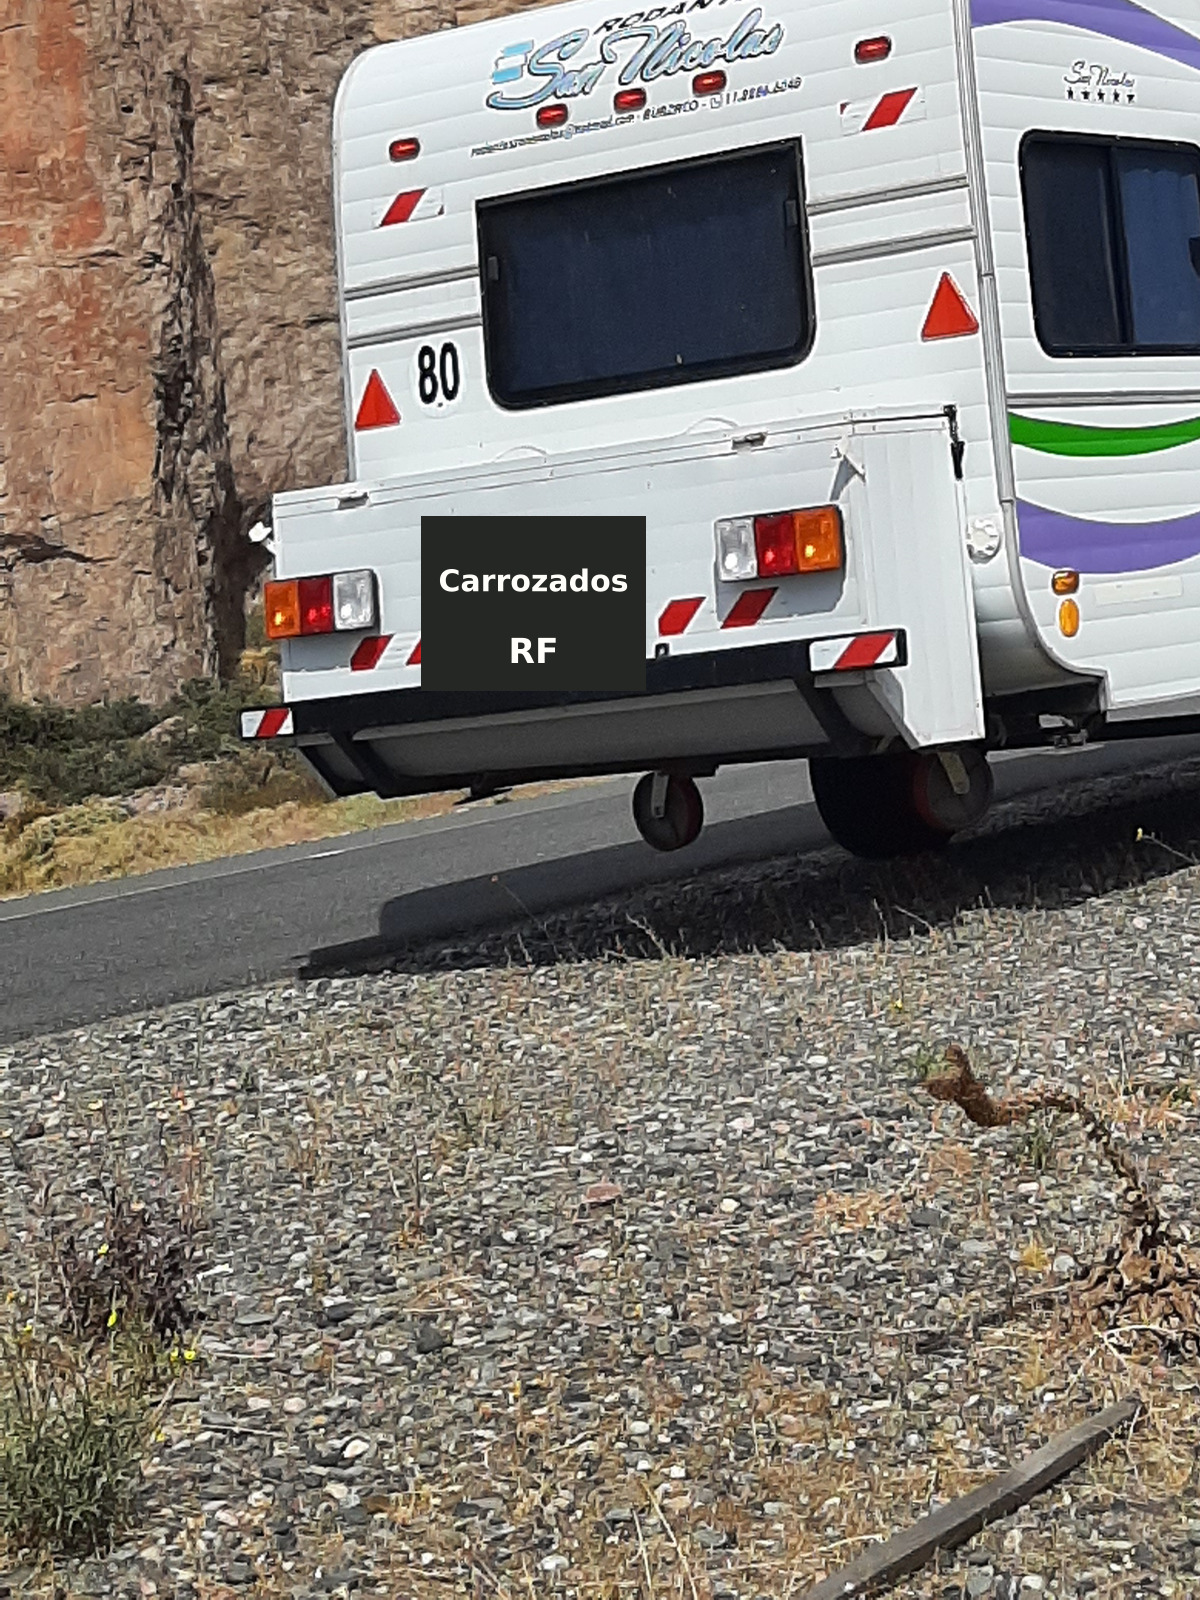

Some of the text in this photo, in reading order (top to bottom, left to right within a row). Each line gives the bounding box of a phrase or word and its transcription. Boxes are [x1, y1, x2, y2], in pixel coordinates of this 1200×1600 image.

[487, 8, 784, 111] San Nicolas
[417, 341, 460, 404] 80
